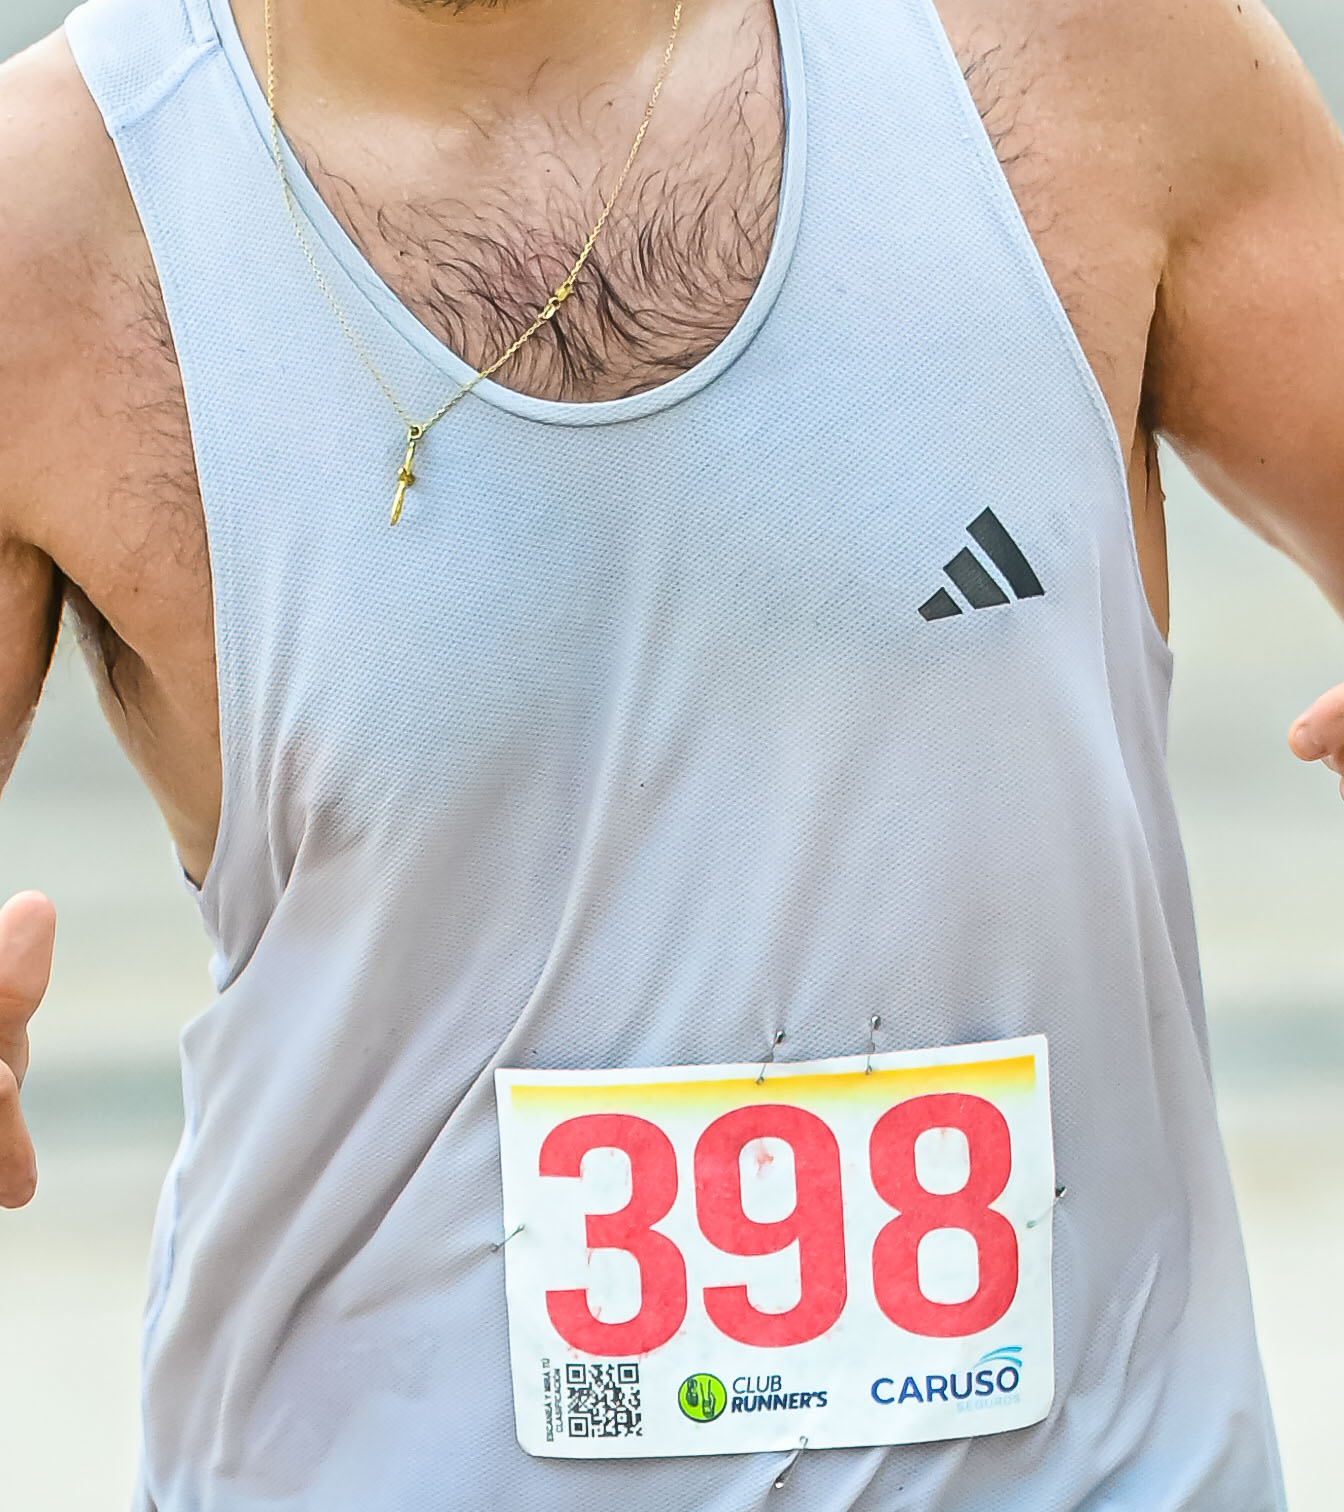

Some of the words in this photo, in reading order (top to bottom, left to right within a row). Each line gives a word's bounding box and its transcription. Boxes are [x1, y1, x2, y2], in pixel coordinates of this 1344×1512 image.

[538, 1091, 1020, 1357] 398
[732, 1375, 782, 1394] CLUB
[871, 1366, 1019, 1405] CARUSO
[731, 1391, 828, 1413] RUNNER'S
[957, 1393, 1021, 1413] SEGUROS
